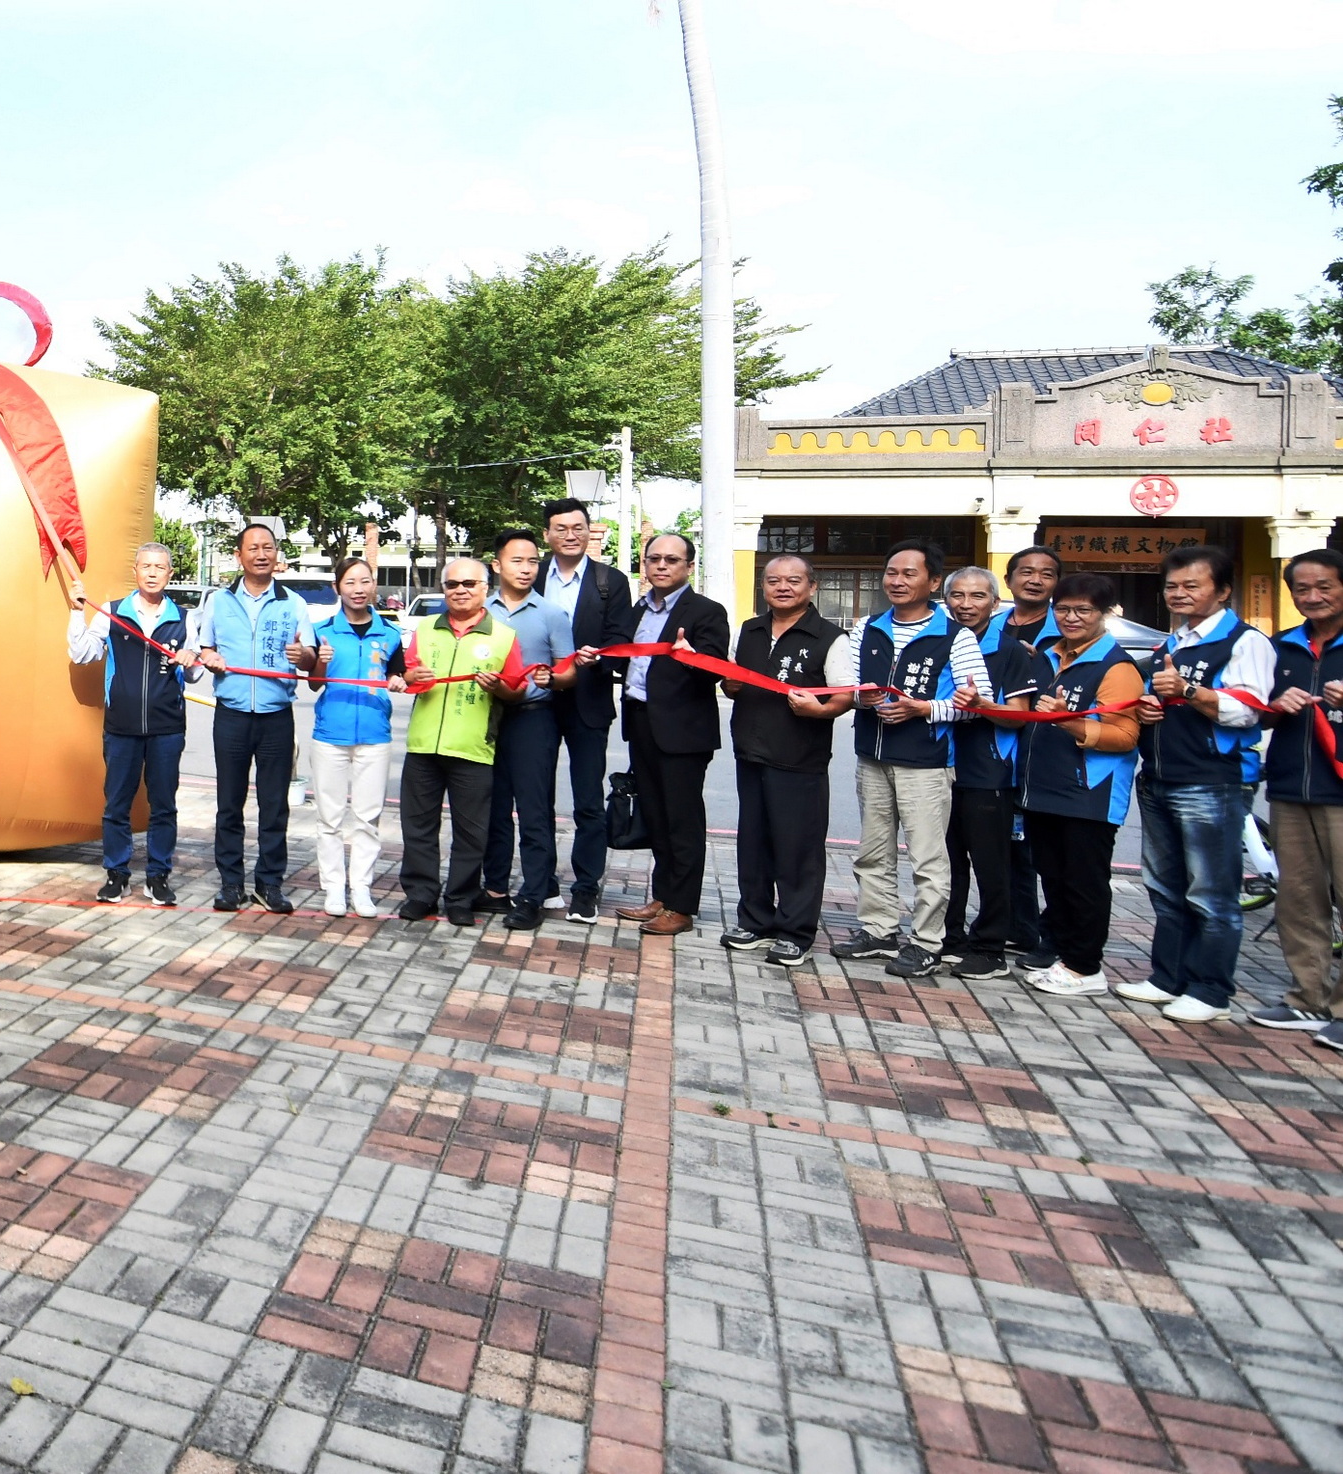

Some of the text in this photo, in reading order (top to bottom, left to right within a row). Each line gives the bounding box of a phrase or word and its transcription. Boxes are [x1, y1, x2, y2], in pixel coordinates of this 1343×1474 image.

[1074, 418, 1234, 445] 同仁社
[262, 620, 278, 668] 鄭俊雄
